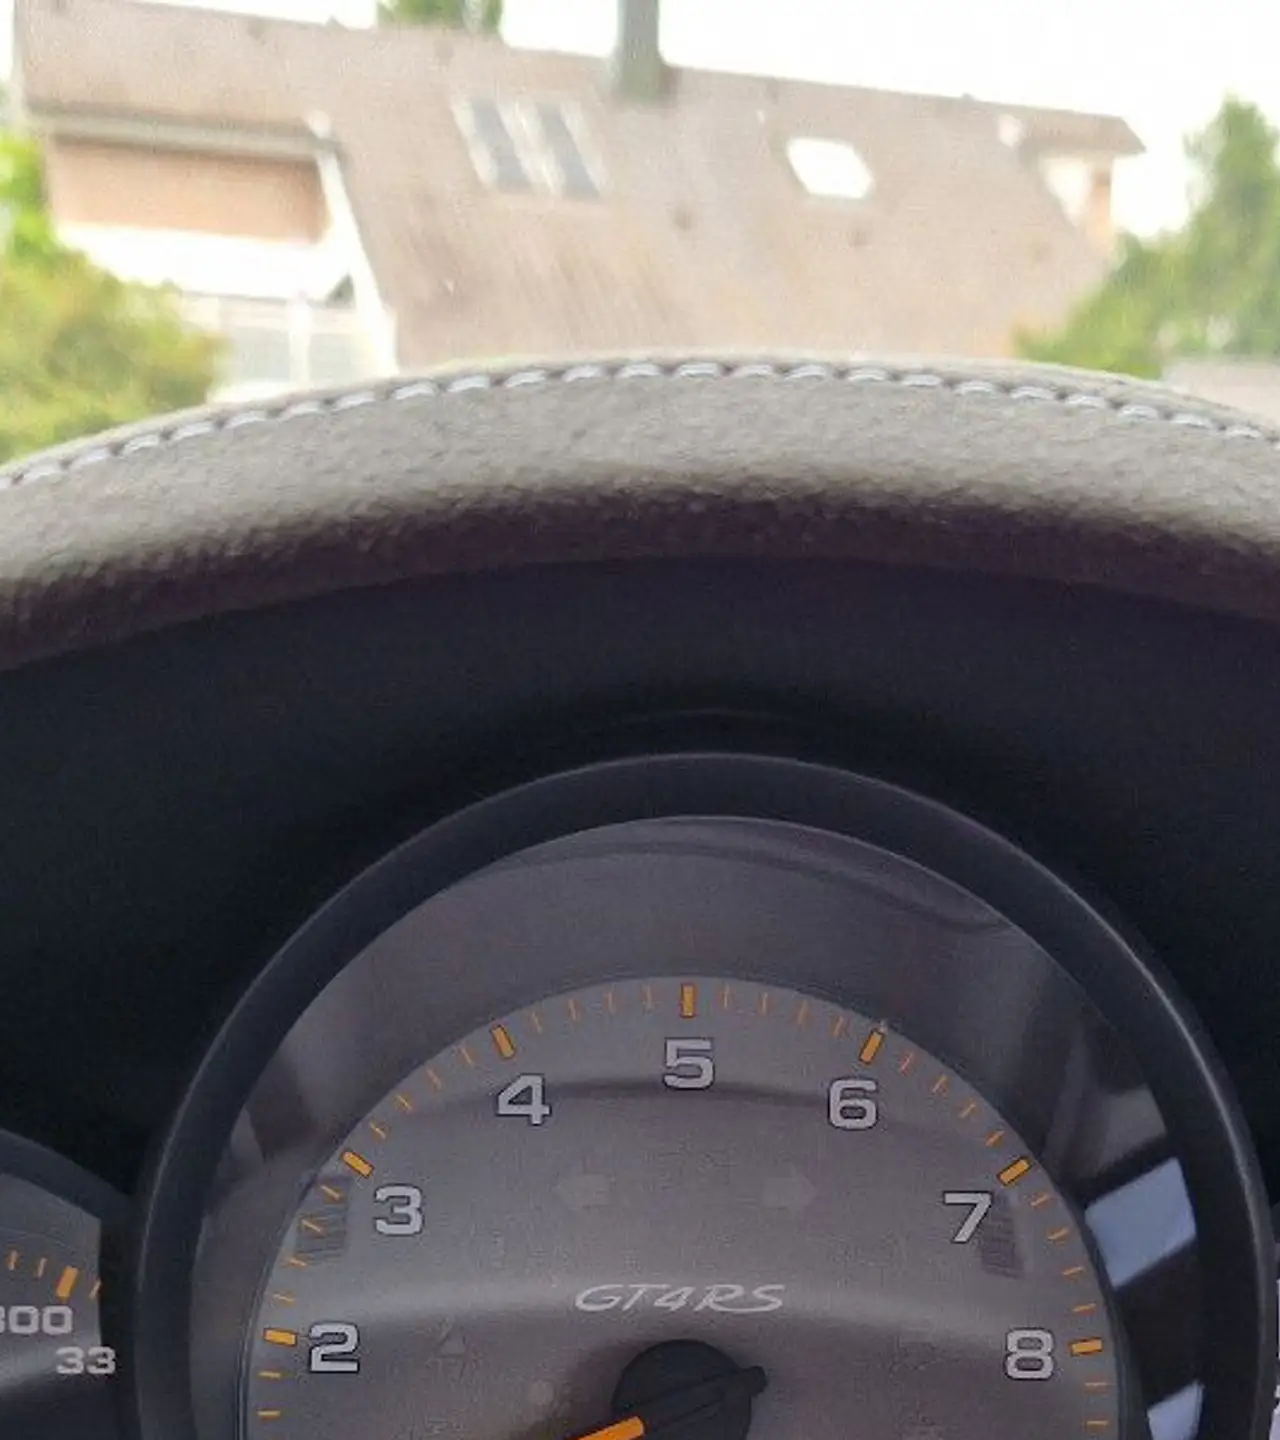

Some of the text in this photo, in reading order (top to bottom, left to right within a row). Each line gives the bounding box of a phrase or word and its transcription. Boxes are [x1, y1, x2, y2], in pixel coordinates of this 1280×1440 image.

[664, 1037, 715, 1091] 5
[496, 1074, 551, 1126] 4
[827, 1078, 877, 1131] 6
[373, 1184, 423, 1236] 3
[942, 1191, 993, 1244] 7
[308, 1322, 359, 1373] 2
[1005, 1327, 1055, 1380] 8
